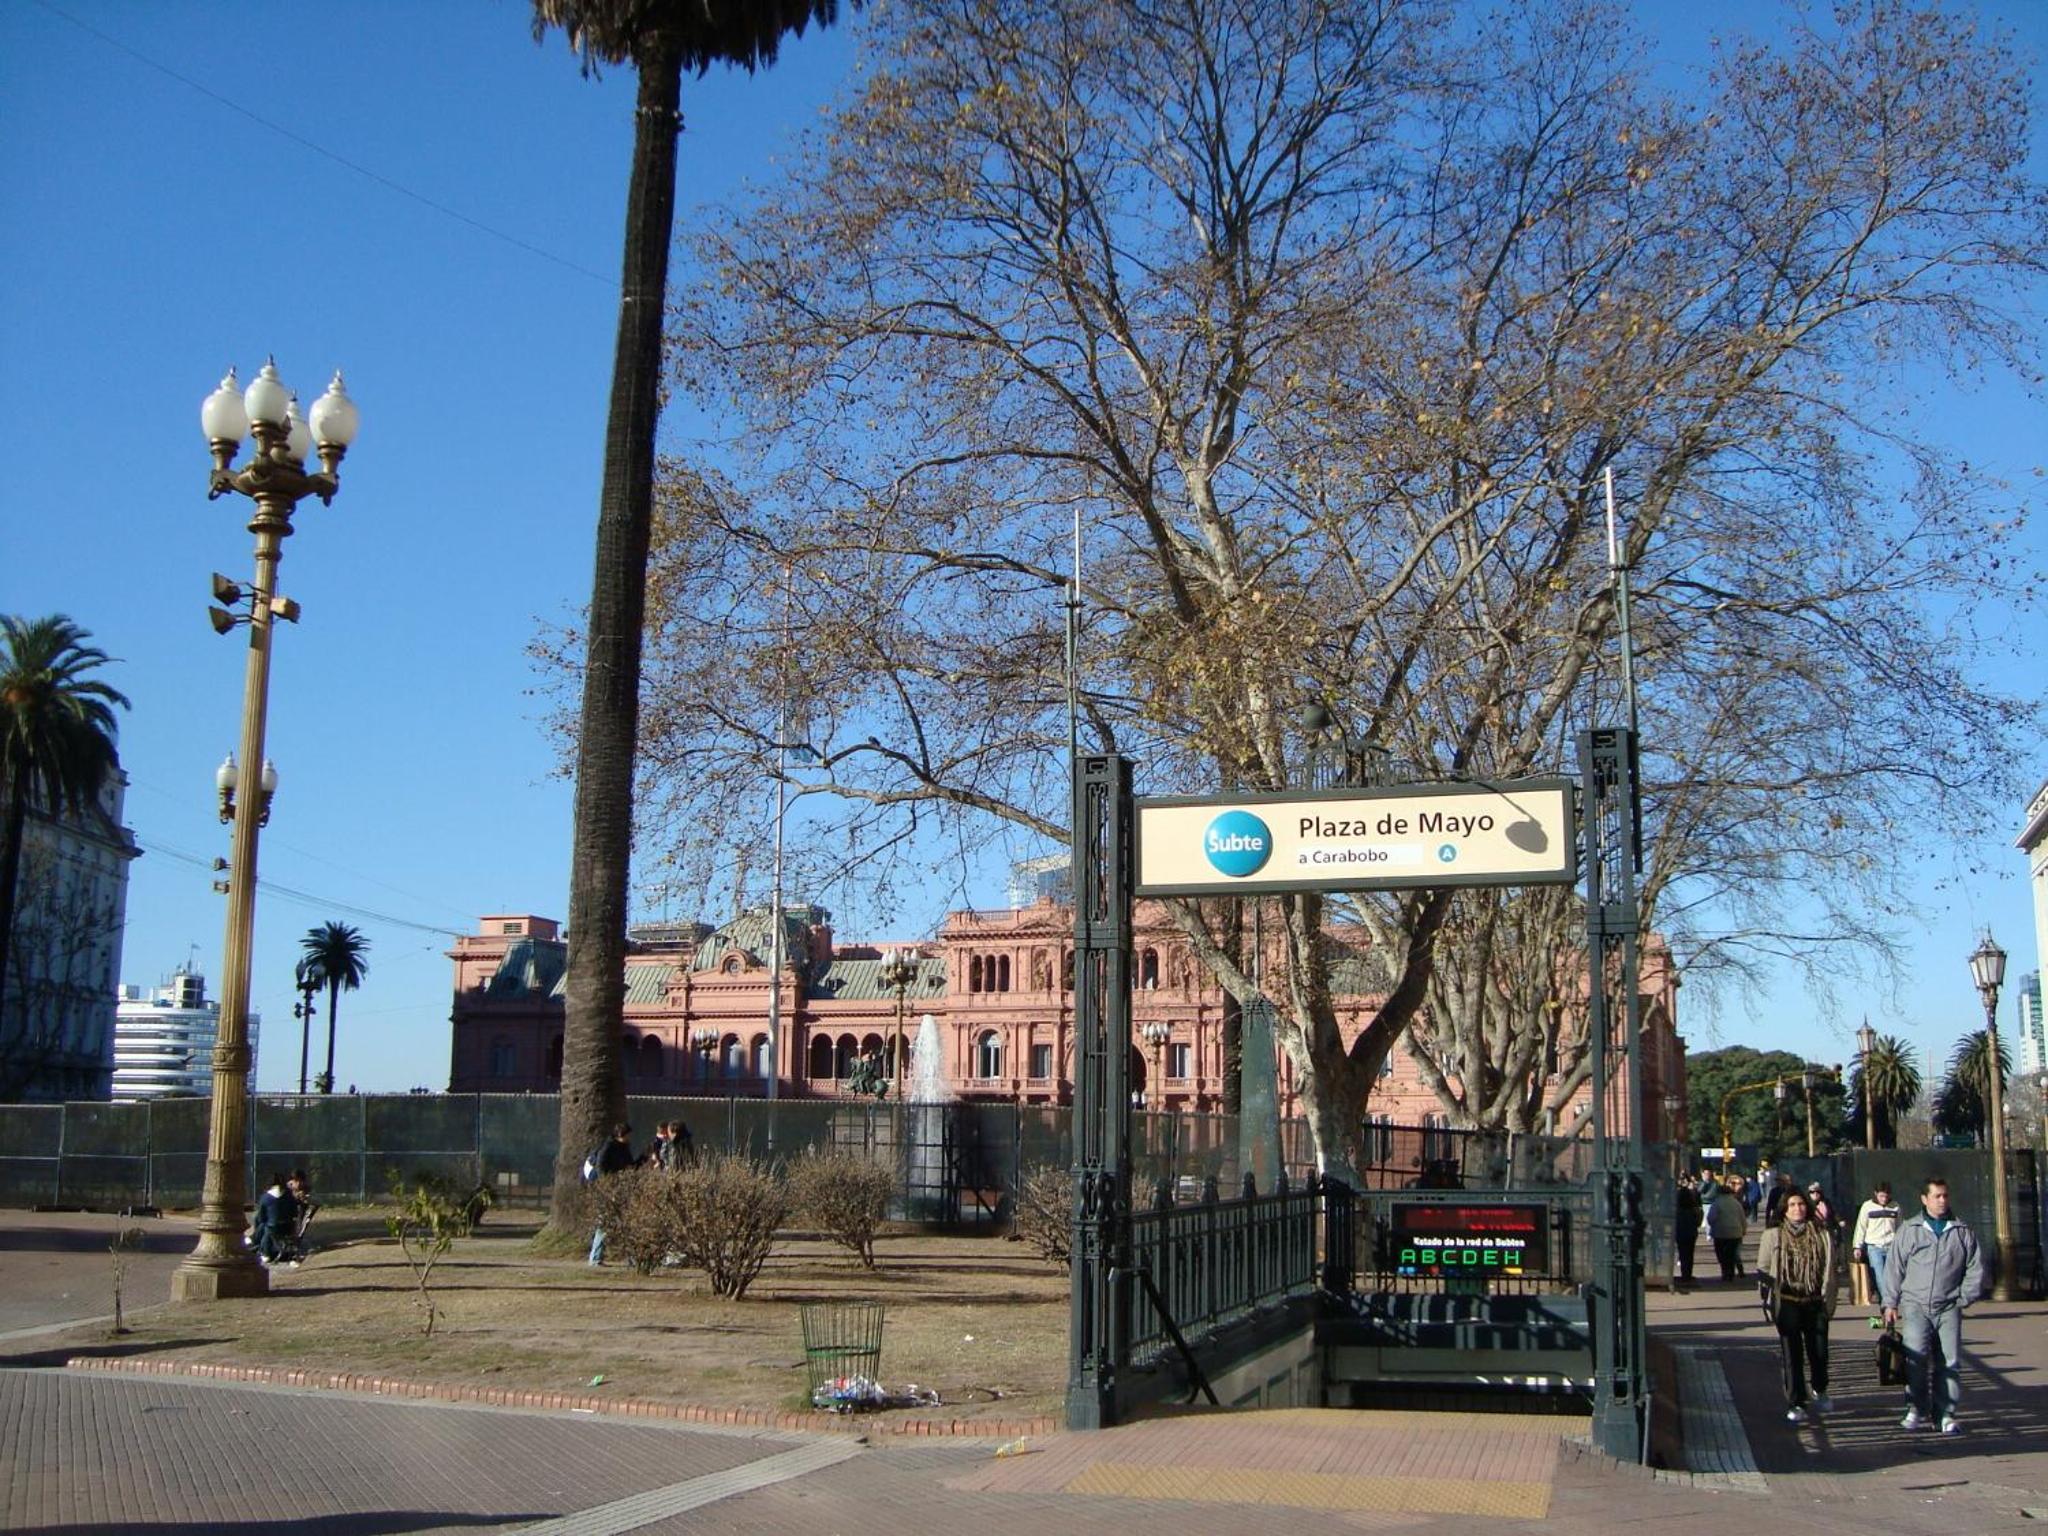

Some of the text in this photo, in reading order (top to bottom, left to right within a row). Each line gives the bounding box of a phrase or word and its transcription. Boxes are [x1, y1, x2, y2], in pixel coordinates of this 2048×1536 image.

[1300, 811, 1494, 838] Plaza de Mayo
[1208, 830, 1264, 853] Subte
[1299, 848, 1388, 865] a Carabobo
